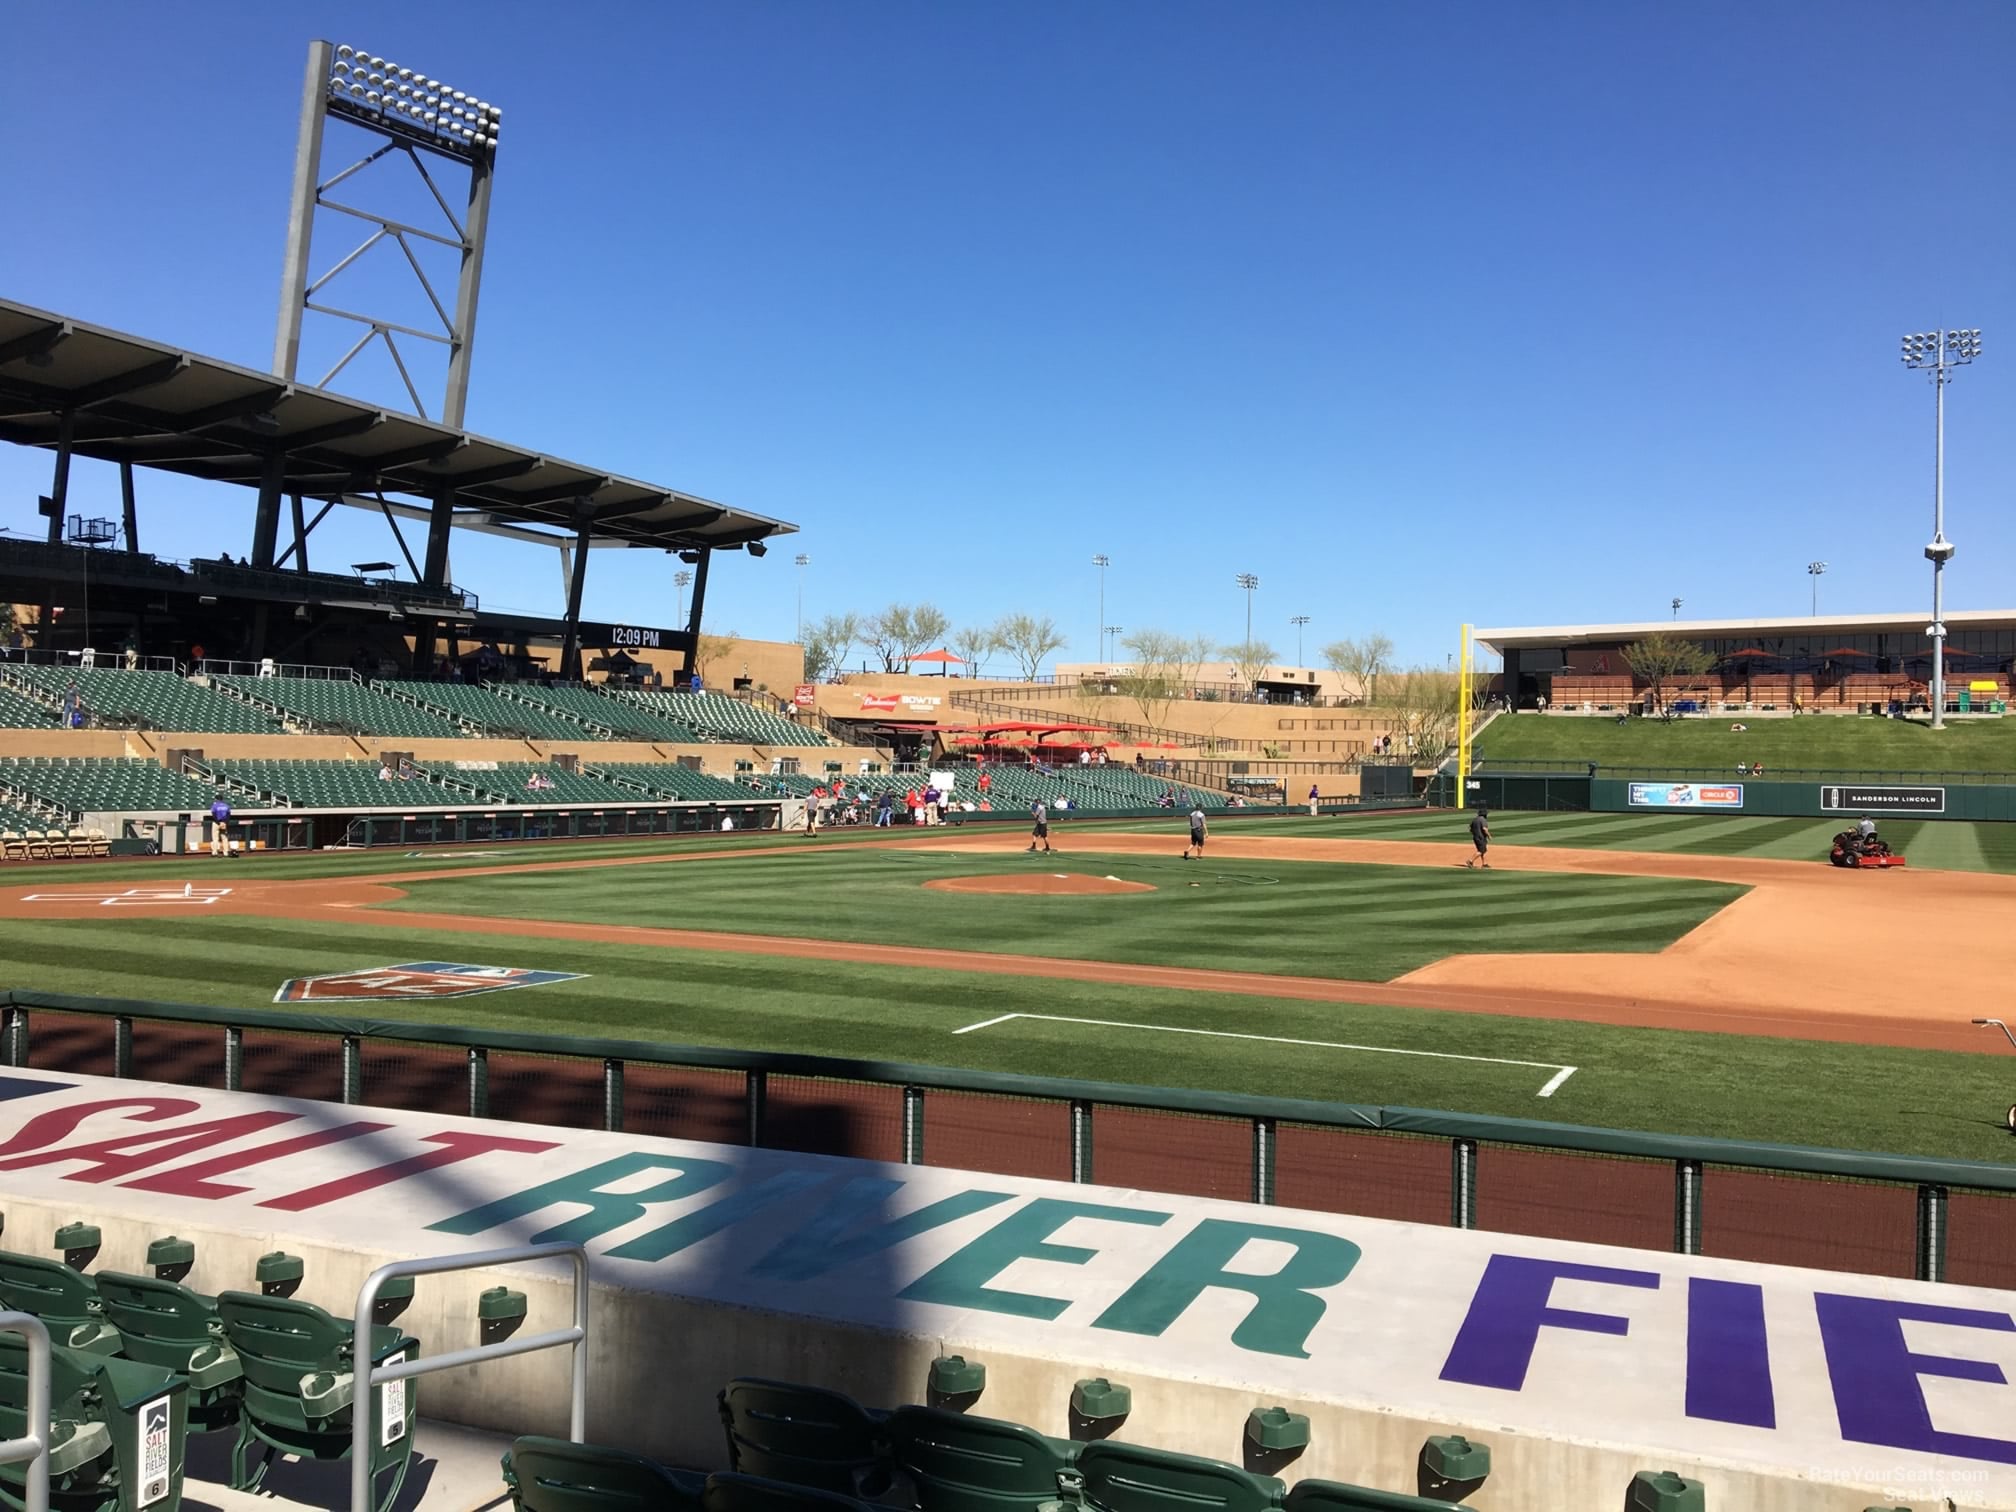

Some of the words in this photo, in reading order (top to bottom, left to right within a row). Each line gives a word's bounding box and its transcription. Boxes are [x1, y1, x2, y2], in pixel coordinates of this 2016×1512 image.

[612, 627, 641, 645] 12:09
[642, 630, 660, 647] PM
[0, 1097, 564, 1211] SALT
[422, 1151, 1362, 1360] RIVER
[145, 1429, 168, 1450] SALT
[392, 1424, 399, 1436] 5
[145, 1443, 168, 1461] RIVER
[145, 1455, 167, 1476] FIELDS
[151, 1482, 160, 1496] 6
